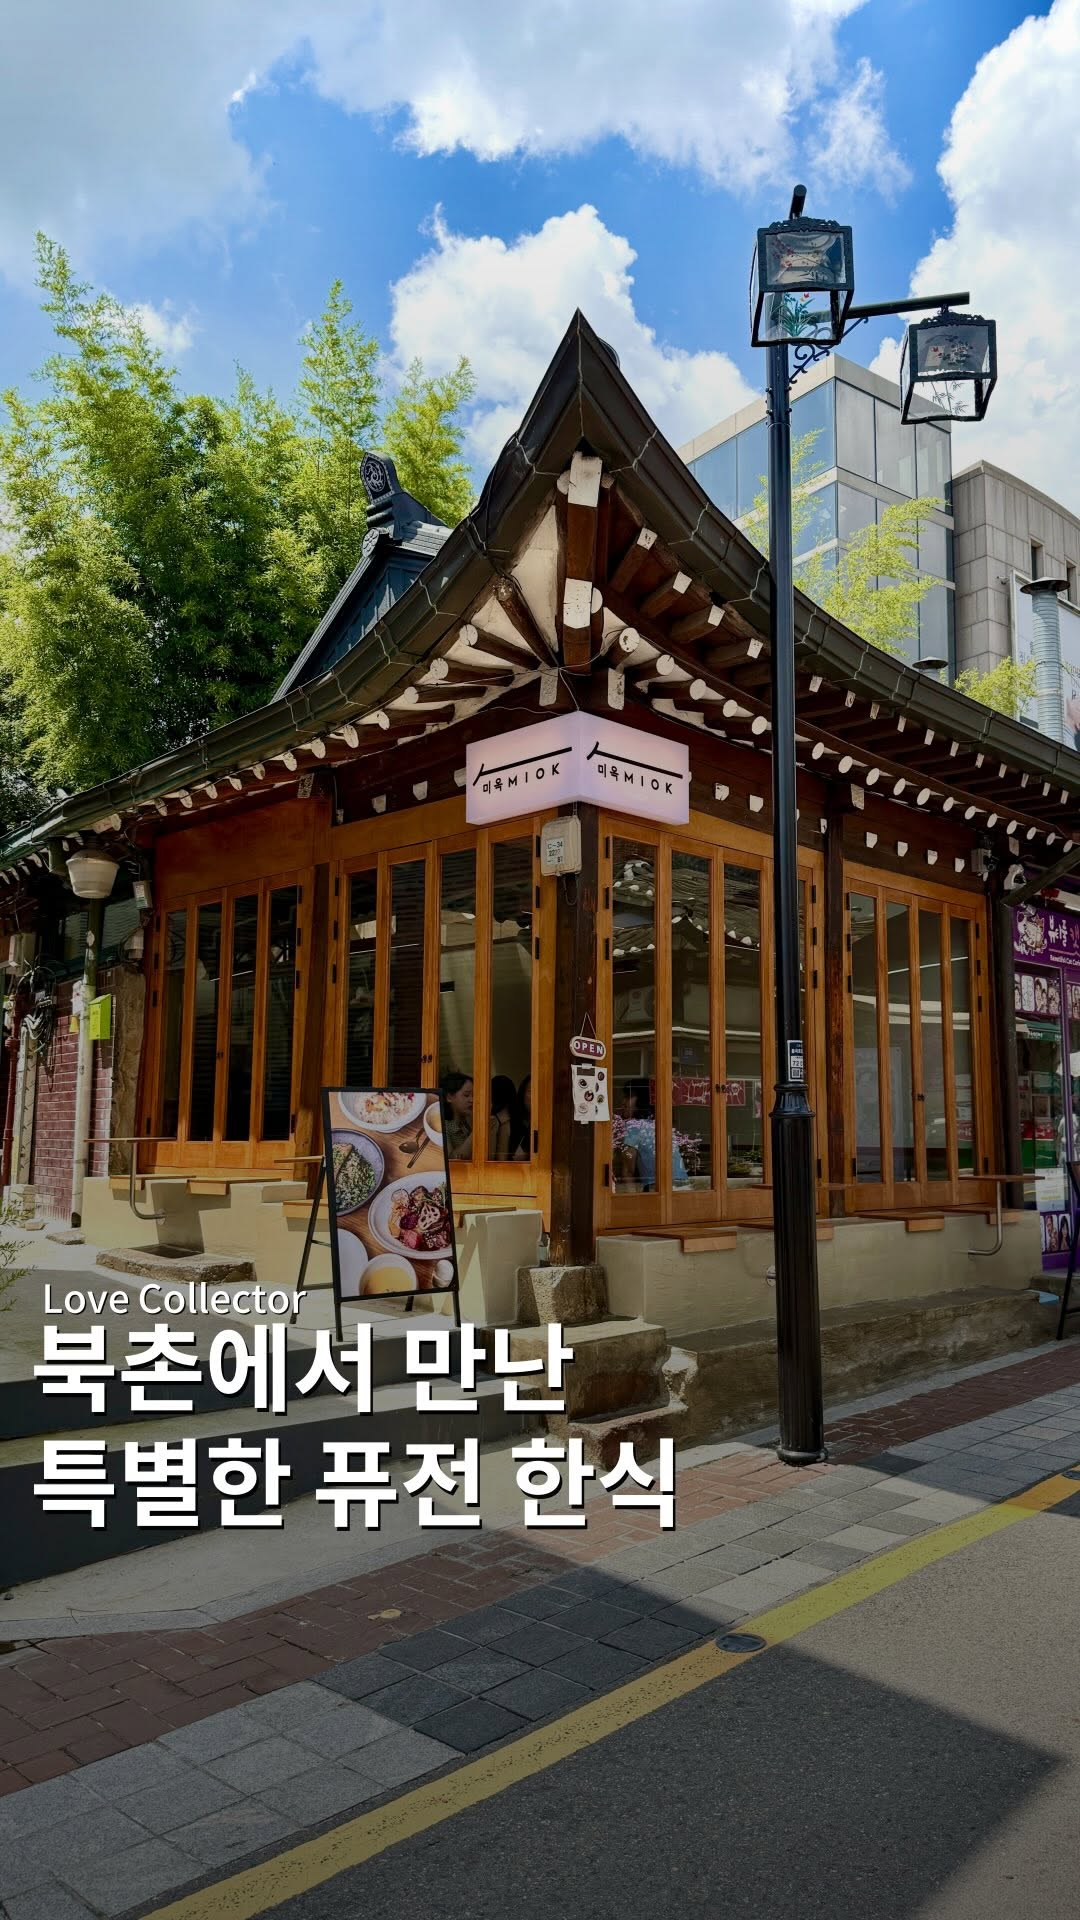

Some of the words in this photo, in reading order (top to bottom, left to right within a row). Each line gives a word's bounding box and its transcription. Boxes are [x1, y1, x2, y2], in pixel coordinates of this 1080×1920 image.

[482, 777, 503, 794] 미옥
[508, 763, 560, 788] MIOK
[597, 763, 619, 782] 미옥
[624, 772, 673, 795] MIOK
[574, 1041, 603, 1054] OPEN
